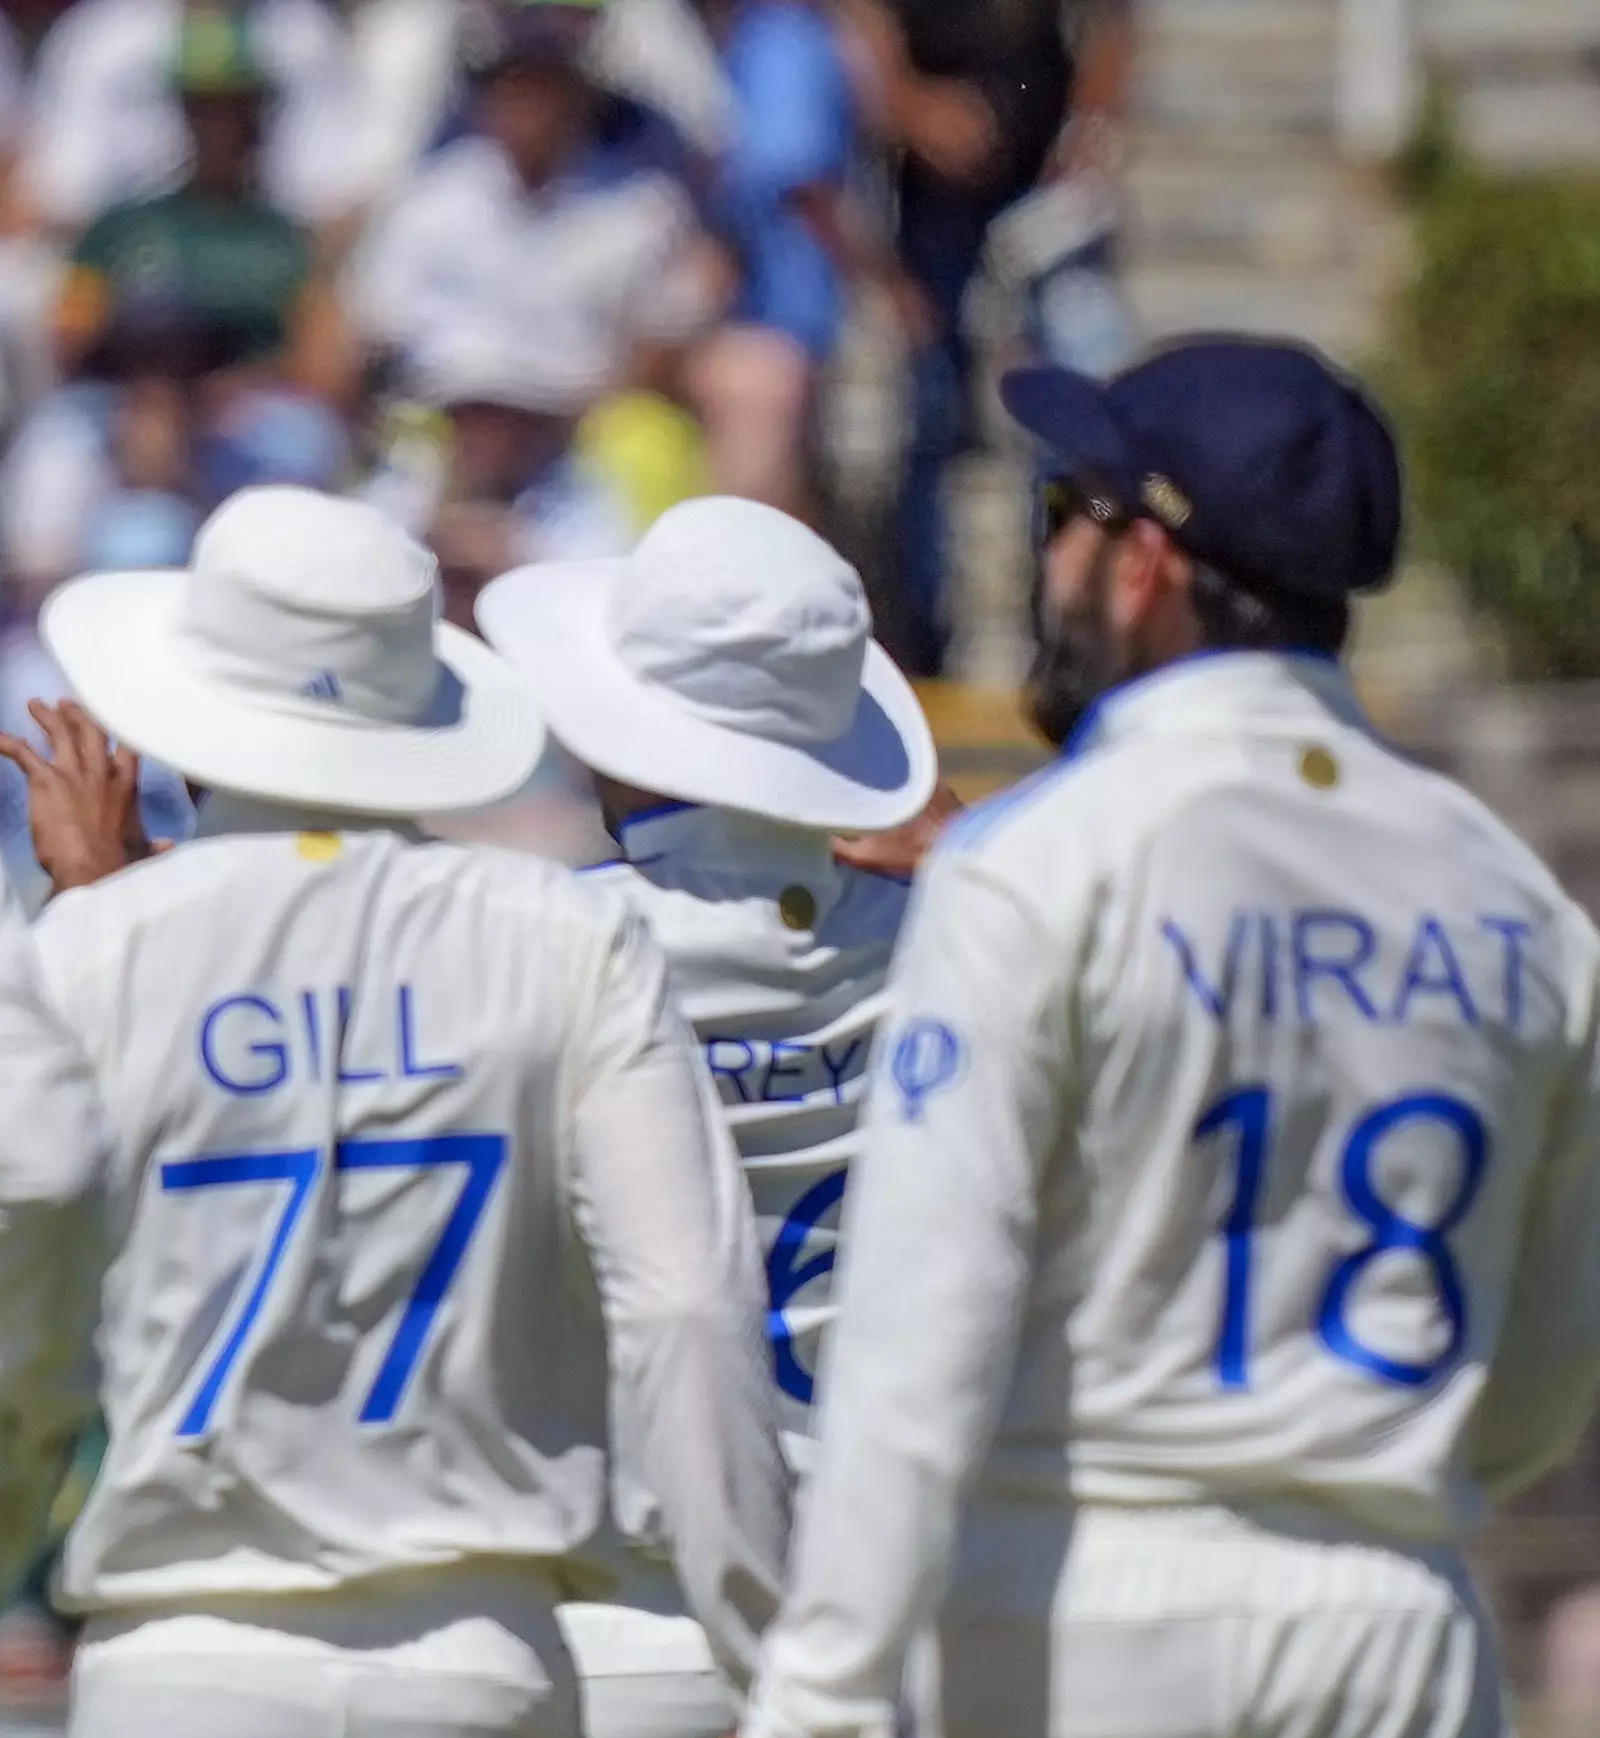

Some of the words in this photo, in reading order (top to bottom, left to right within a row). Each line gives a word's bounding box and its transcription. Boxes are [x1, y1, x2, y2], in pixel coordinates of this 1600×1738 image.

[201, 984, 464, 1097] GILL
[1162, 912, 1530, 1034] VIRAT
[161, 1133, 509, 1437] 77
[1193, 1082, 1484, 1388] 18
